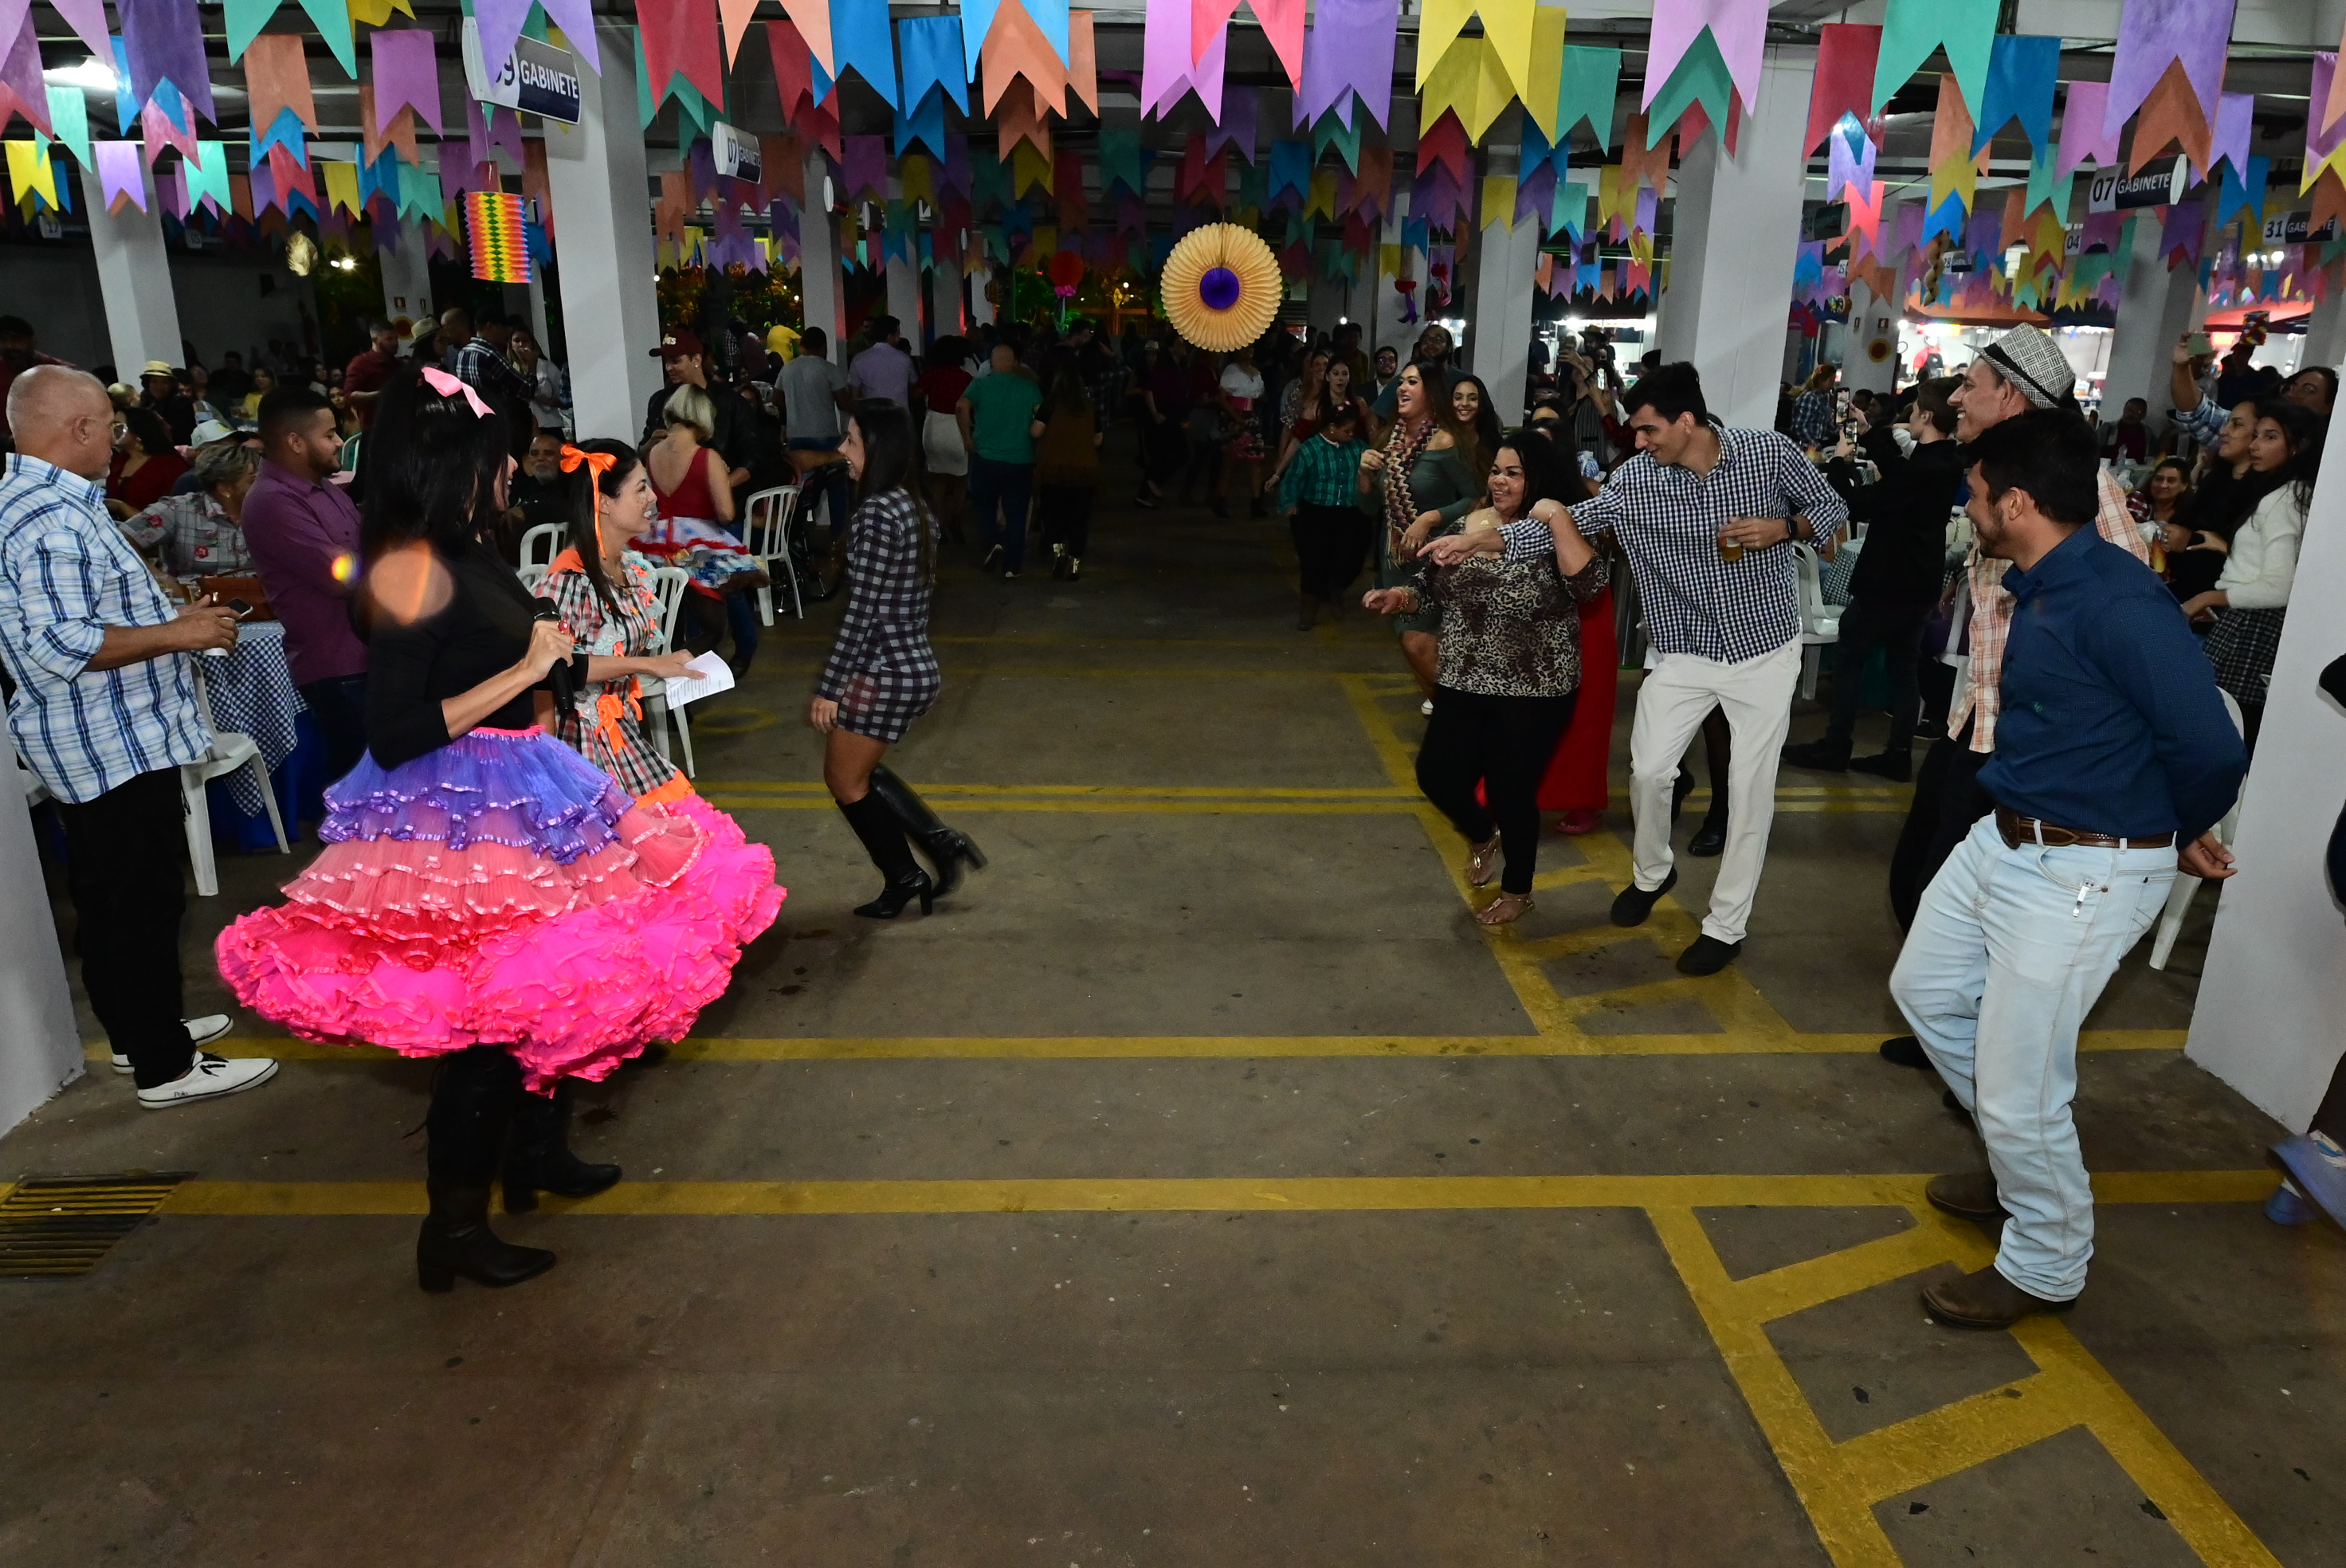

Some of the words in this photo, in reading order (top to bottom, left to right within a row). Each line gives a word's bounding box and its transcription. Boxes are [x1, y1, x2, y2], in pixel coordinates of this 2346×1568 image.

[520, 60, 579, 99] GABINETE
[728, 136, 737, 164] 07
[2093, 177, 2115, 202] 07
[2117, 172, 2171, 194] GABINETE
[2266, 220, 2283, 238] 31
[2287, 219, 2334, 233] GABE
[2066, 236, 2080, 249] 04
[1944, 257, 1952, 269] 28
